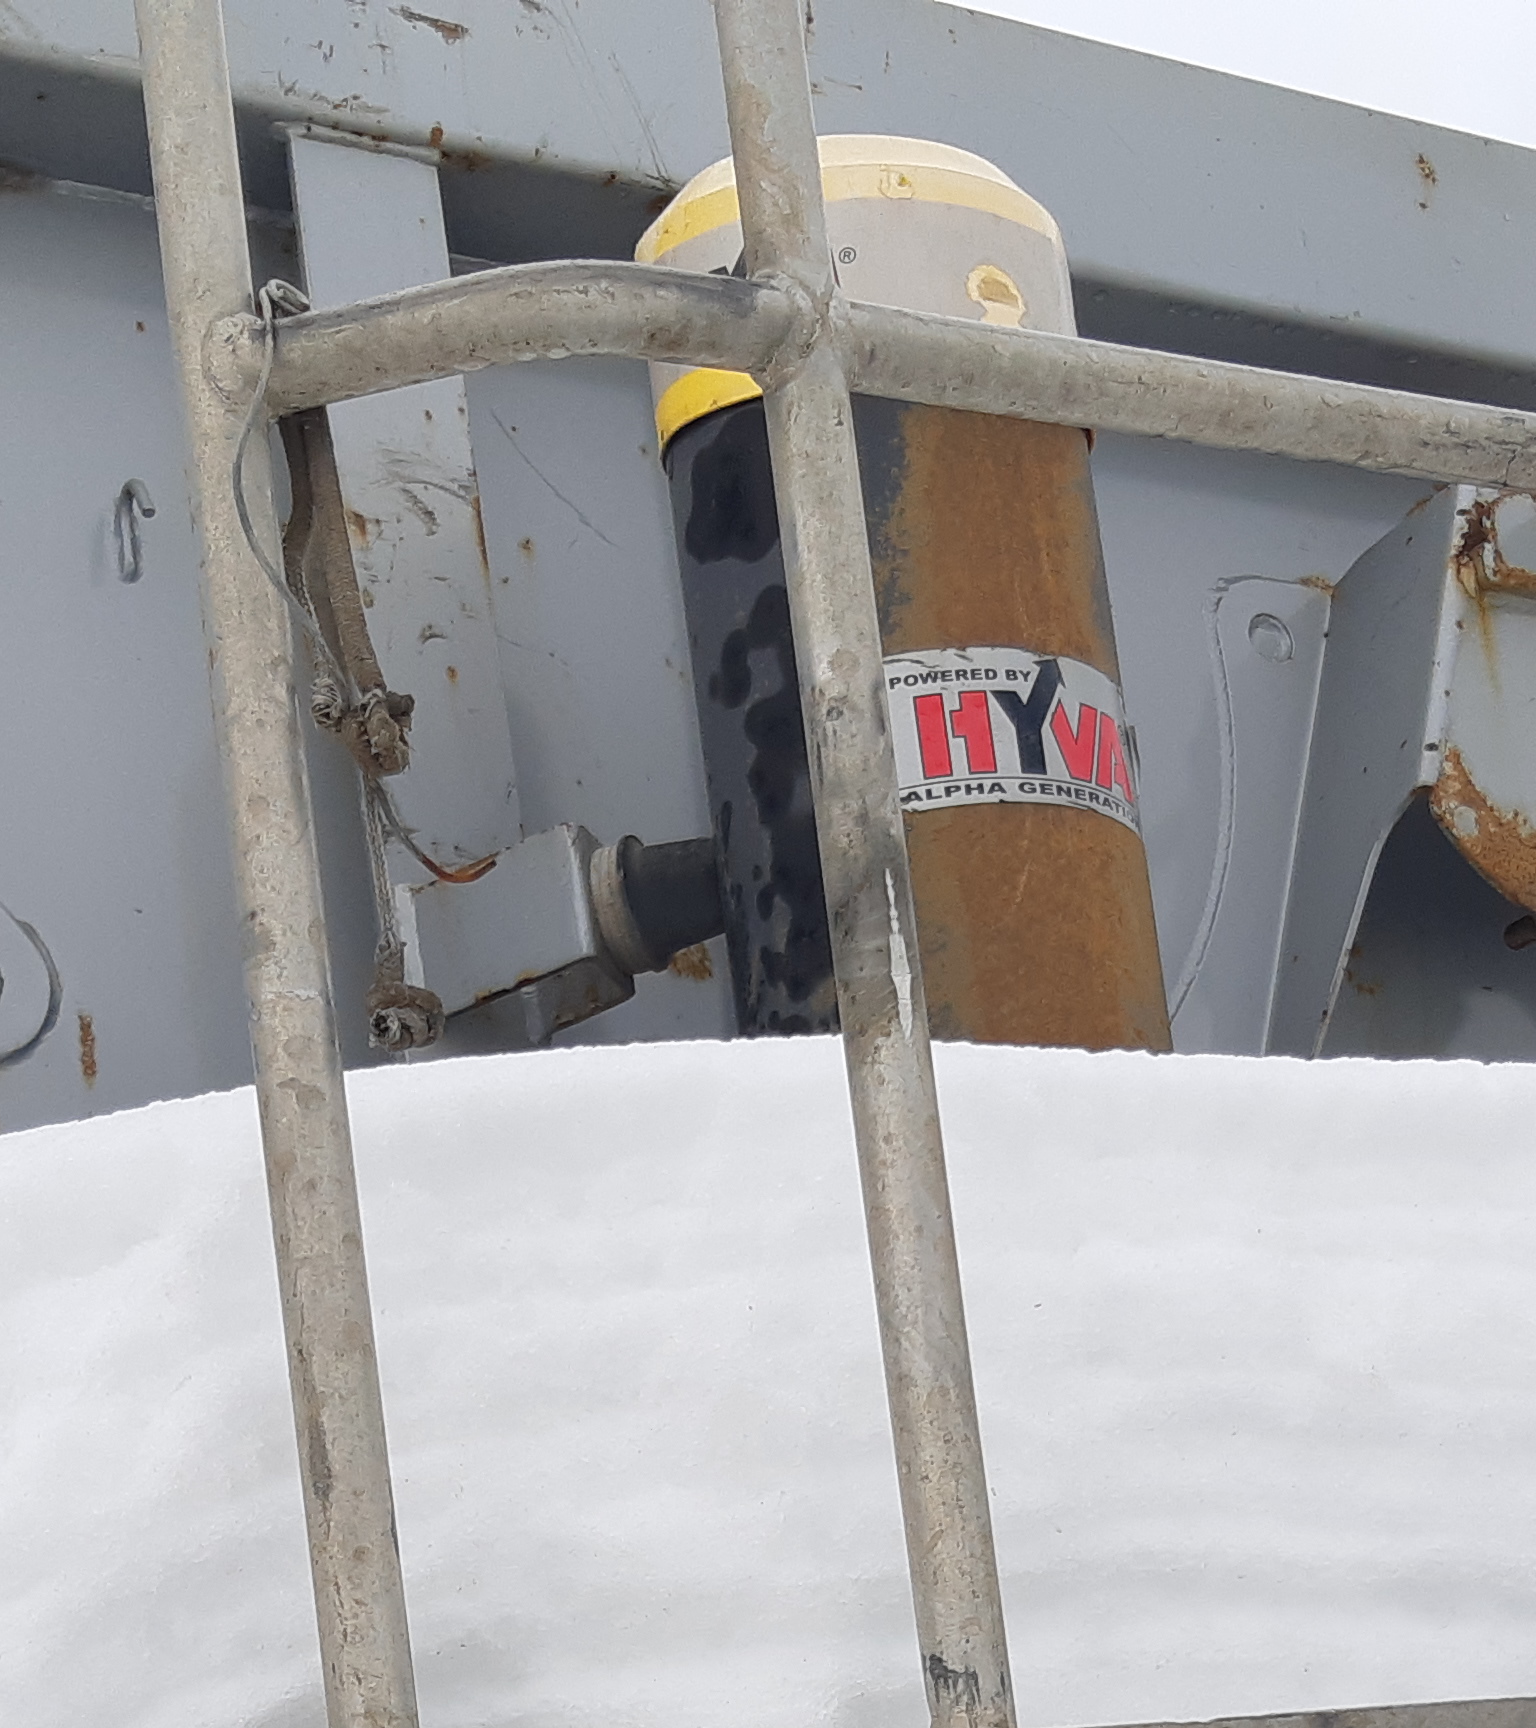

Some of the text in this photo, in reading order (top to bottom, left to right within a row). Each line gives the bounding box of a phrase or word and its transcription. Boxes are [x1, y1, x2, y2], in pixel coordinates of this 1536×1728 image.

[889, 668, 1031, 690] POWERED BY
[914, 658, 1136, 804] HYVA
[901, 781, 1007, 803] ALPHA
